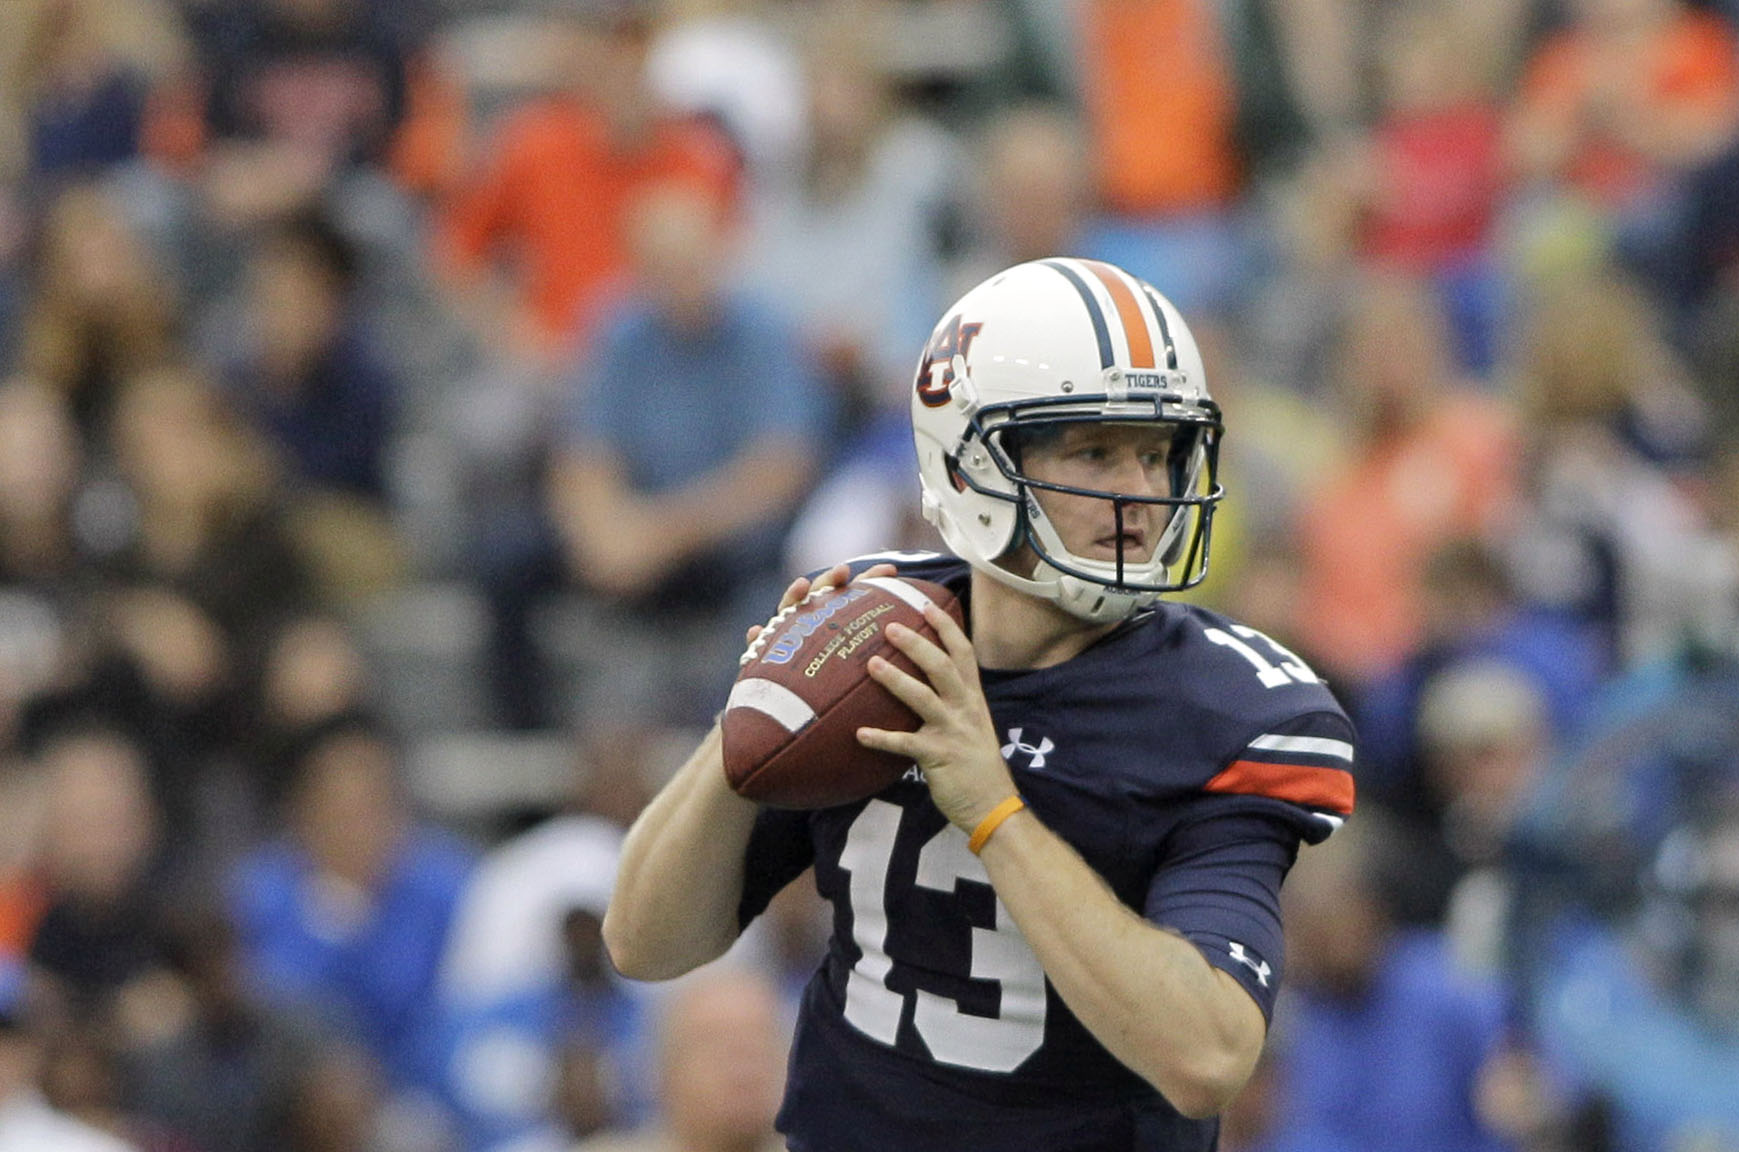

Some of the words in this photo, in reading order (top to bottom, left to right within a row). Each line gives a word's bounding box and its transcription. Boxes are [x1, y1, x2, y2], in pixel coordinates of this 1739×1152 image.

[1124, 374, 1168, 389] TIGERS
[804, 634, 846, 678] COLLEGE
[845, 602, 896, 635] FOOTBALL
[836, 622, 880, 660] PLAYOFF
[838, 799, 1047, 1073] 13
